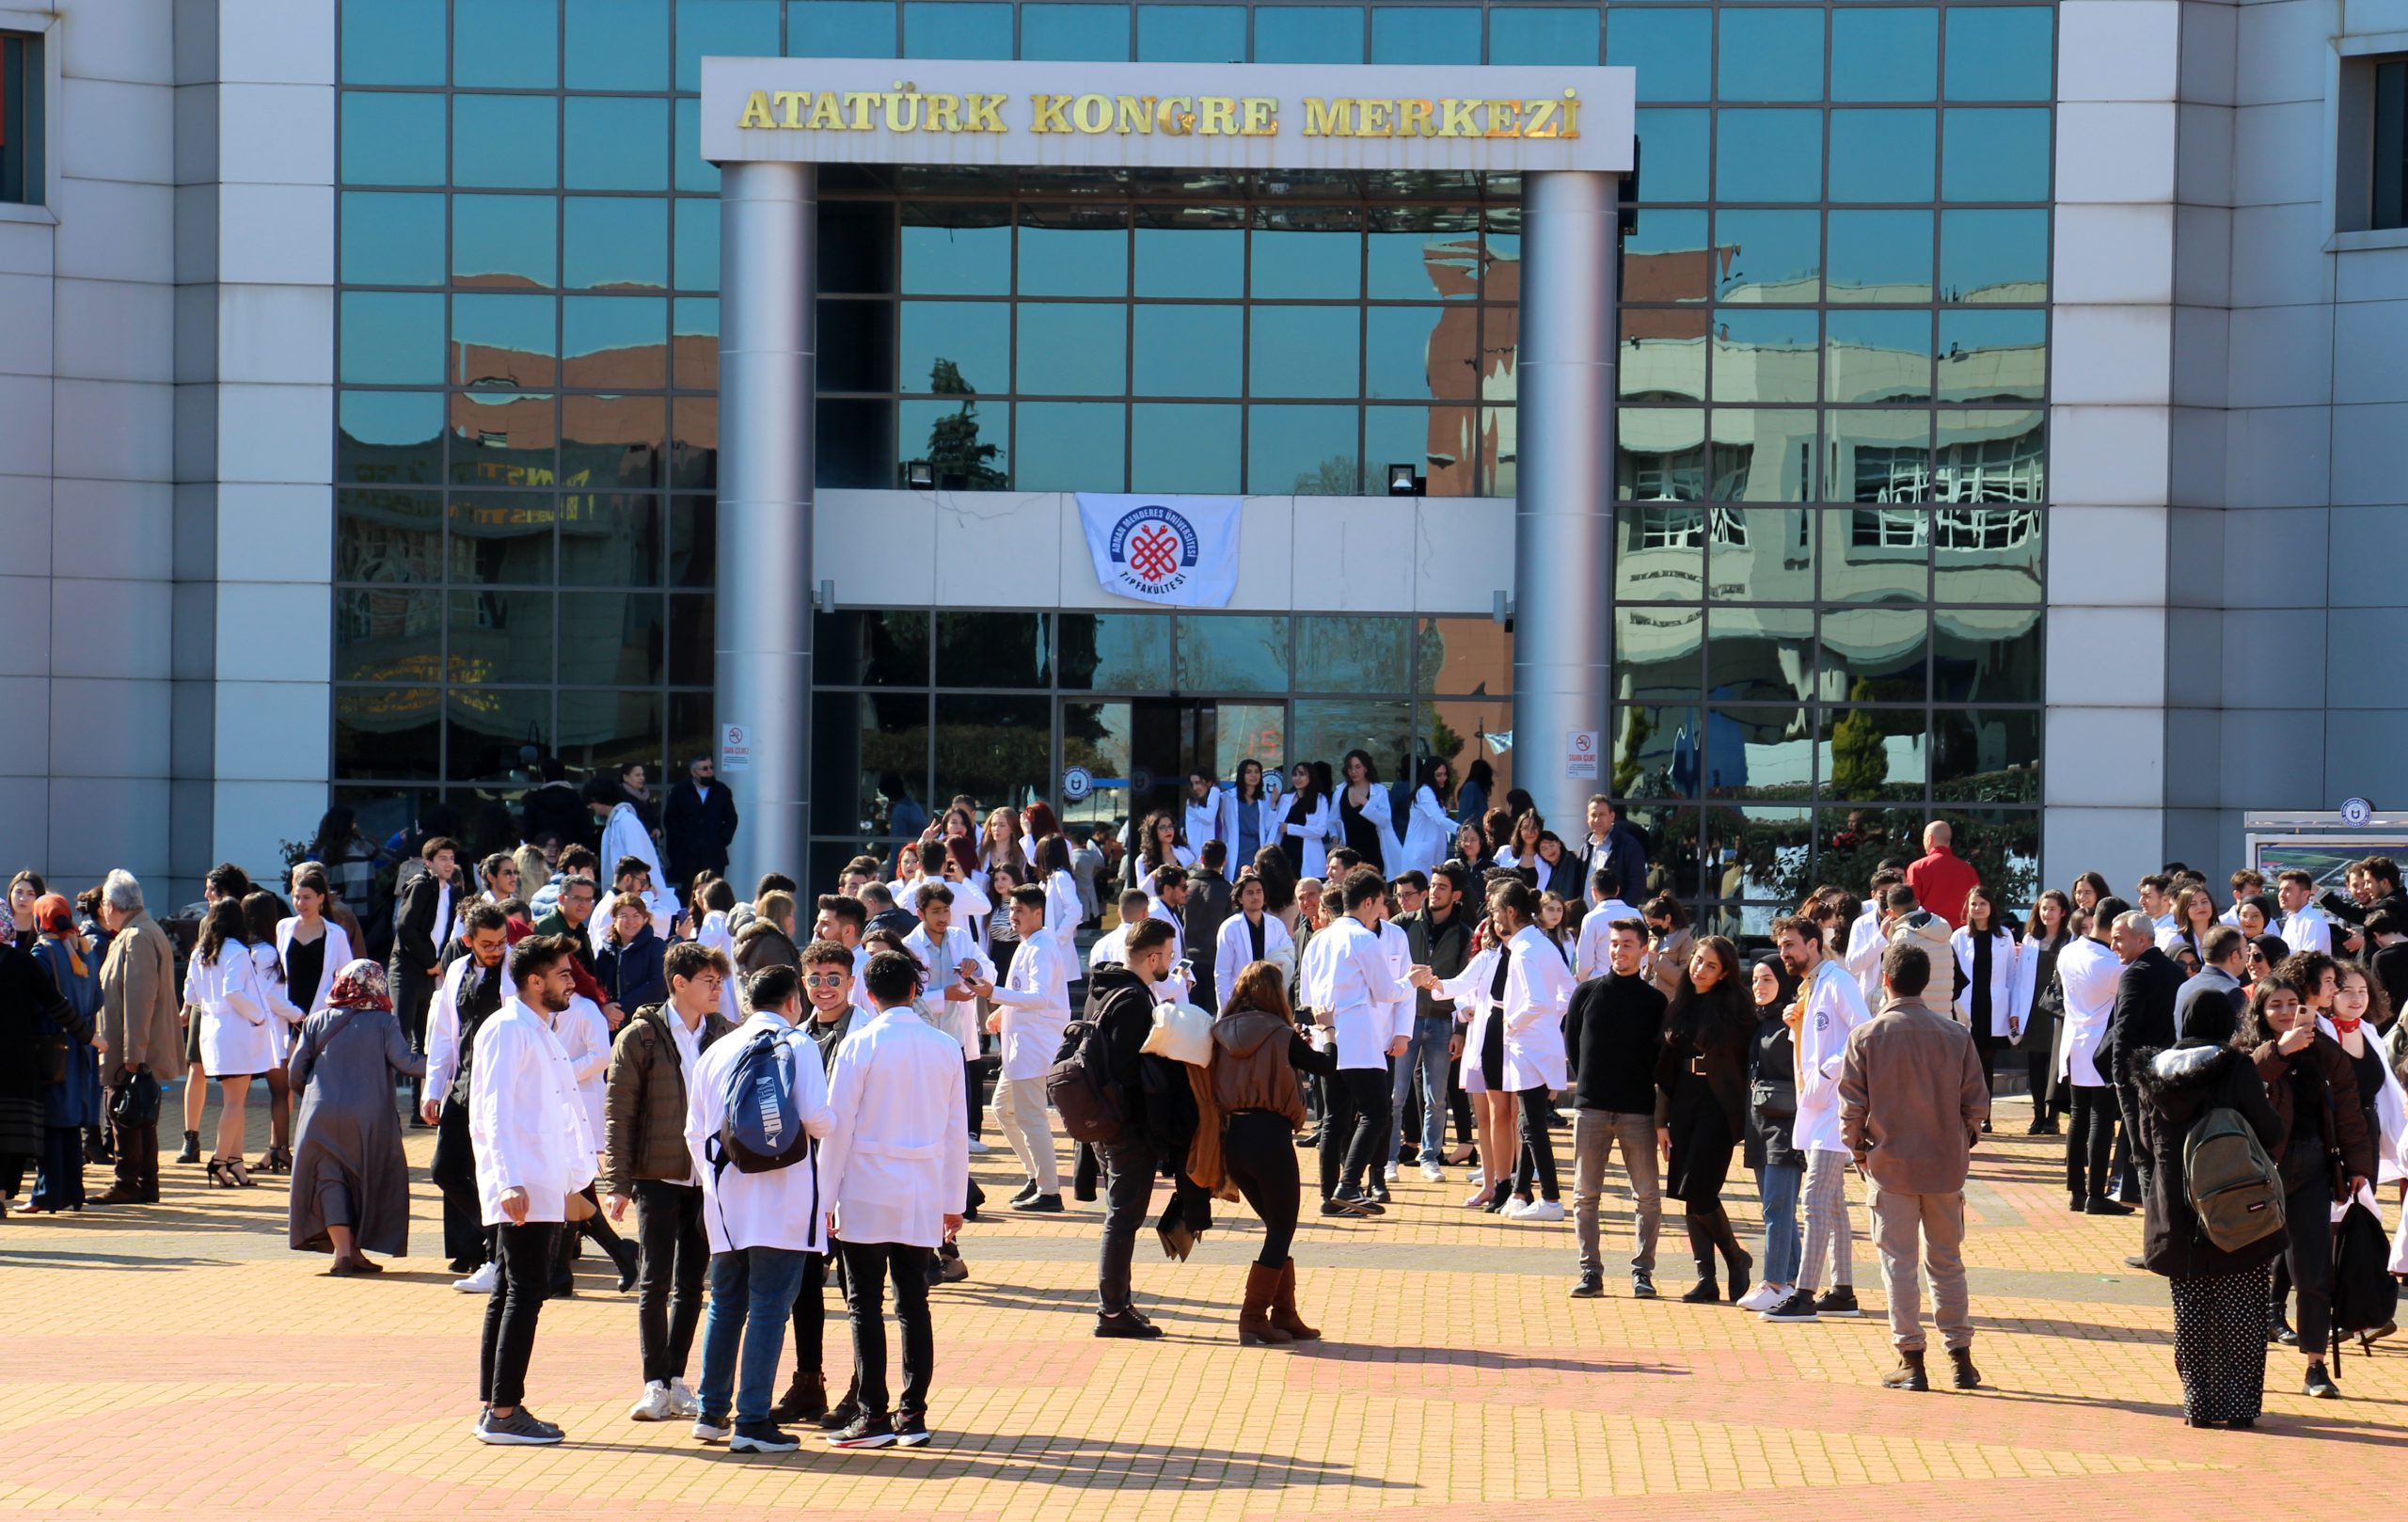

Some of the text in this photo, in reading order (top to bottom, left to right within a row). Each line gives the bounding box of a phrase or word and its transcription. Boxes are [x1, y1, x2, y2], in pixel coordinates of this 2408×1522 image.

[737, 80, 1581, 138] ATATÜRK KONGRE MERKEZİ
[1112, 509, 1196, 557] ADNAN MENDERES ÜNİVERSİTESİ
[756, 1076, 782, 1133] PUMA
